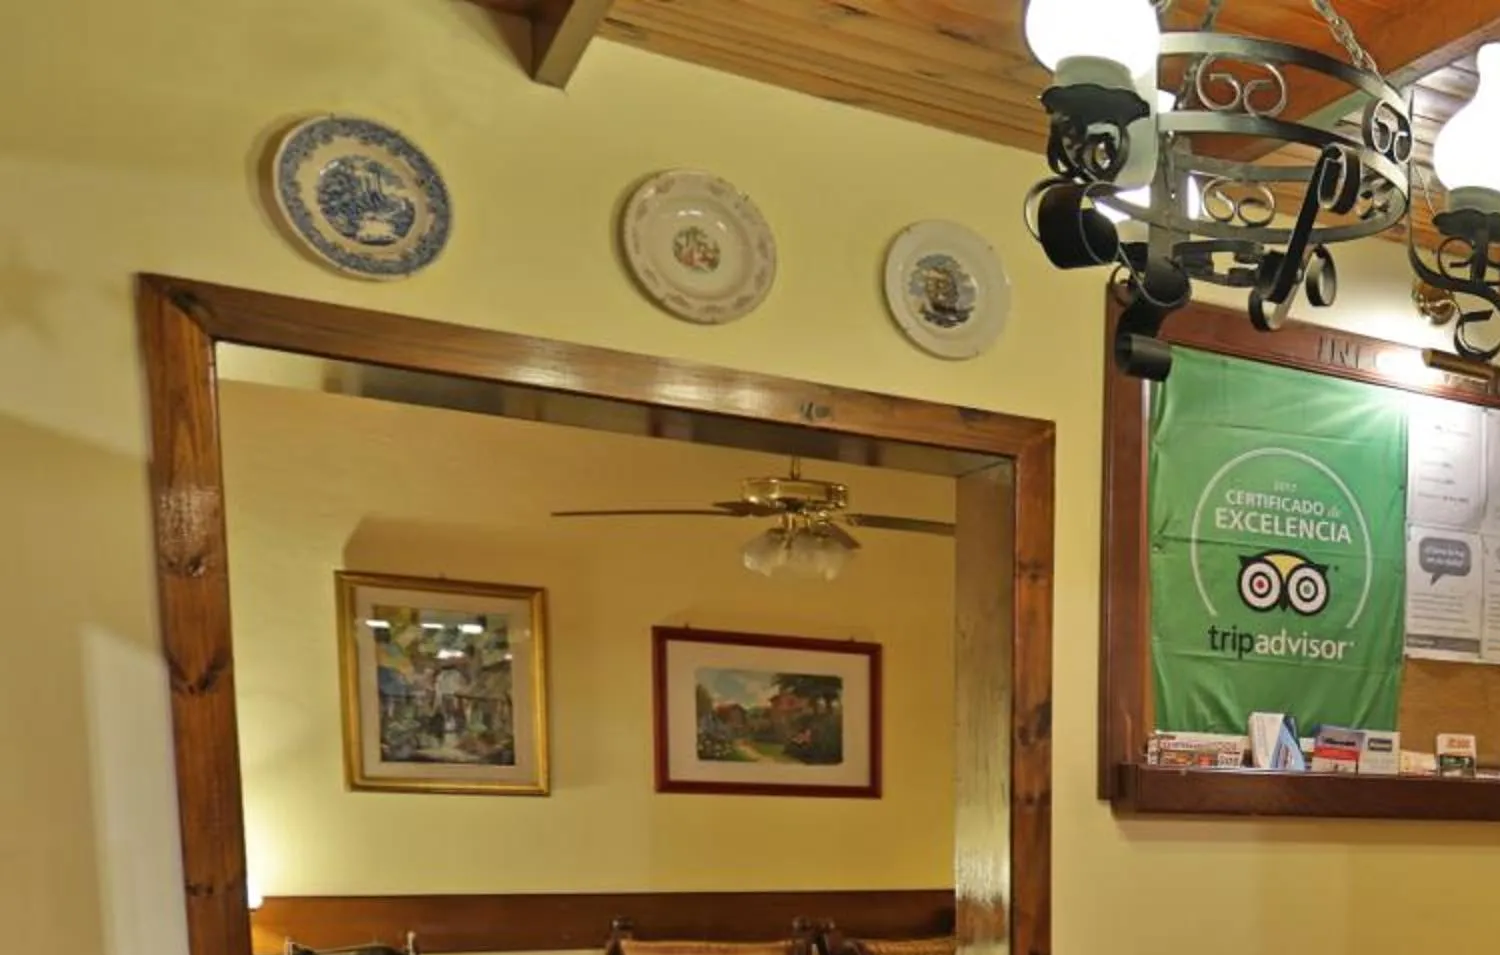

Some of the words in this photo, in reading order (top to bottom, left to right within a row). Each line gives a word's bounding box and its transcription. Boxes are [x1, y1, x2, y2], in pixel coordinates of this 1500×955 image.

[1225, 489, 1325, 517] CERTIFICADO
[1214, 507, 1352, 544] EXCELENCIA
[1208, 624, 1350, 660] tripadvisor
